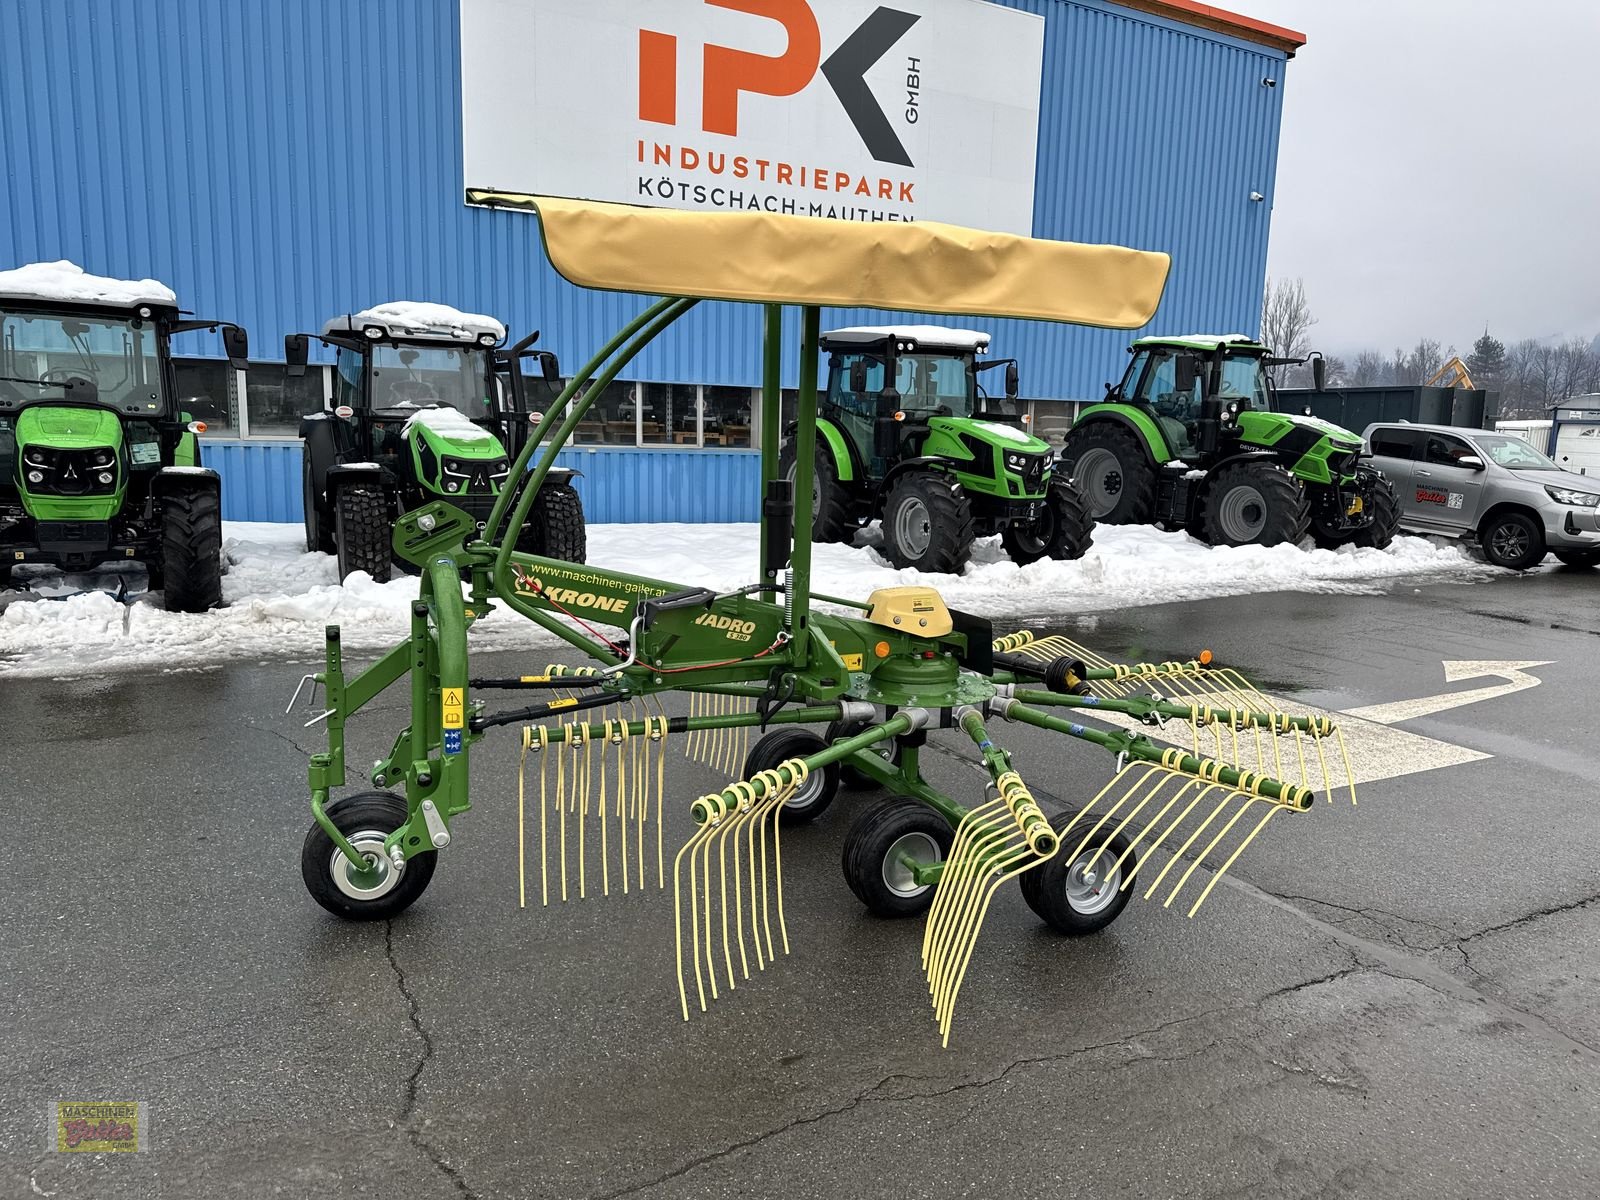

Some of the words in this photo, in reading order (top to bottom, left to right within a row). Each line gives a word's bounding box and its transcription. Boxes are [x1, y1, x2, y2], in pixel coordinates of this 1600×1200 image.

[905, 56, 921, 124] GMBH
[638, 140, 916, 203] INDUSTRIEPARK
[1416, 483, 1449, 493] MASCHINEN
[531, 564, 666, 597] www.maschinen-gailer.at
[543, 586, 629, 613] KRONE
